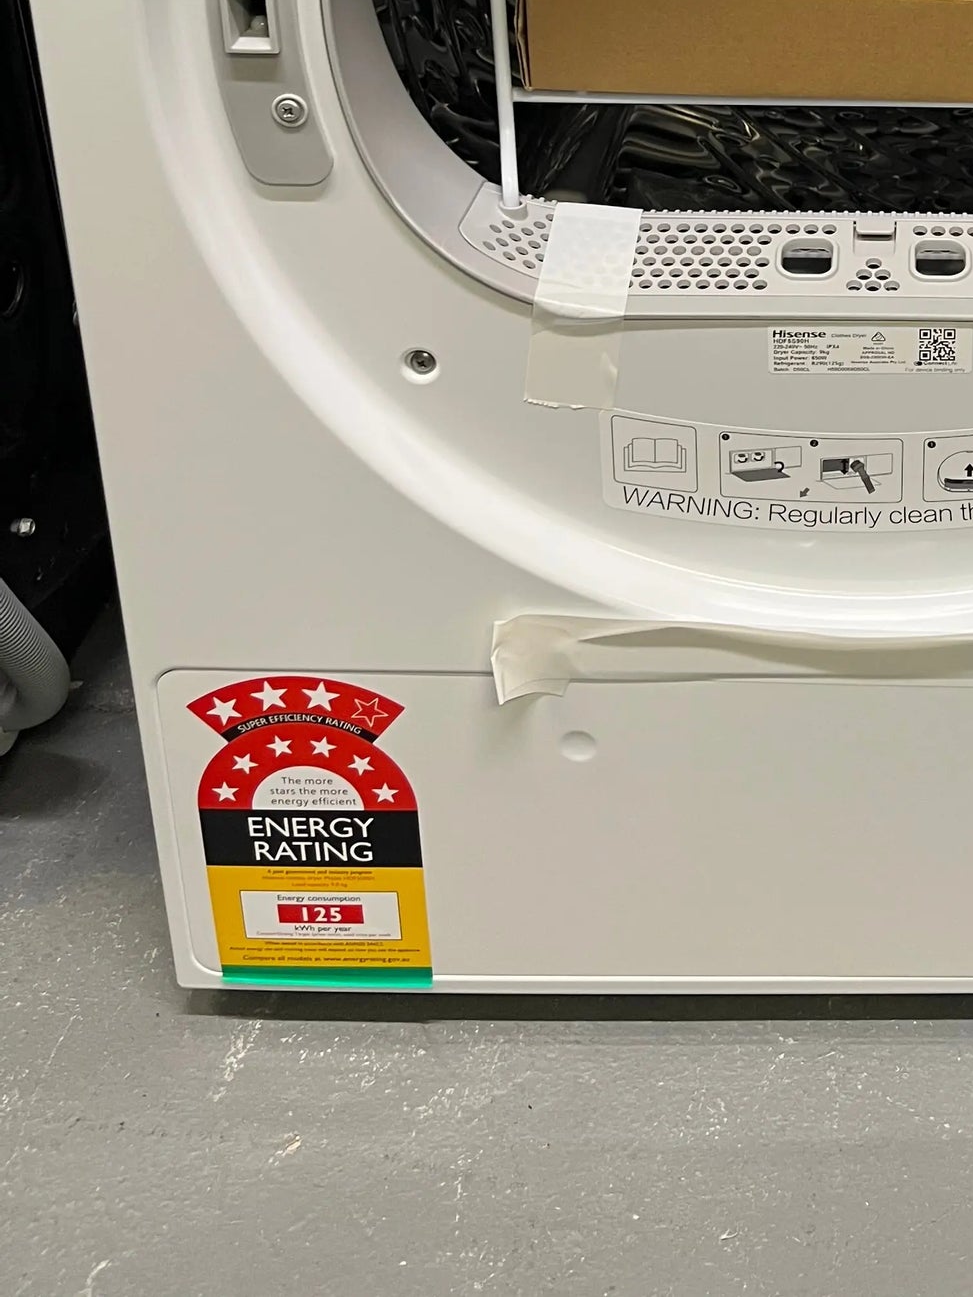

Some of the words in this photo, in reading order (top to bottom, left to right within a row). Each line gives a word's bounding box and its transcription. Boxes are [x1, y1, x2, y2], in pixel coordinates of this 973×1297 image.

[772, 329, 827, 338] Hisense
[622, 484, 760, 520] WARNING:
[768, 502, 882, 529] Regularly
[889, 506, 953, 525] clean
[237, 718, 268, 734] SUPER
[268, 713, 325, 724] EFFICIENCY
[325, 717, 362, 735] RATING
[281, 776, 301, 785] The
[270, 787, 296, 795] stars
[299, 787, 317, 795] the
[271, 797, 309, 807] energy
[311, 797, 356, 806] efficient
[247, 816, 375, 838] ENERGY
[254, 841, 373, 863] RATING
[277, 894, 305, 902] Energy
[301, 906, 342, 922] 125
[317, 925, 331, 933] per
